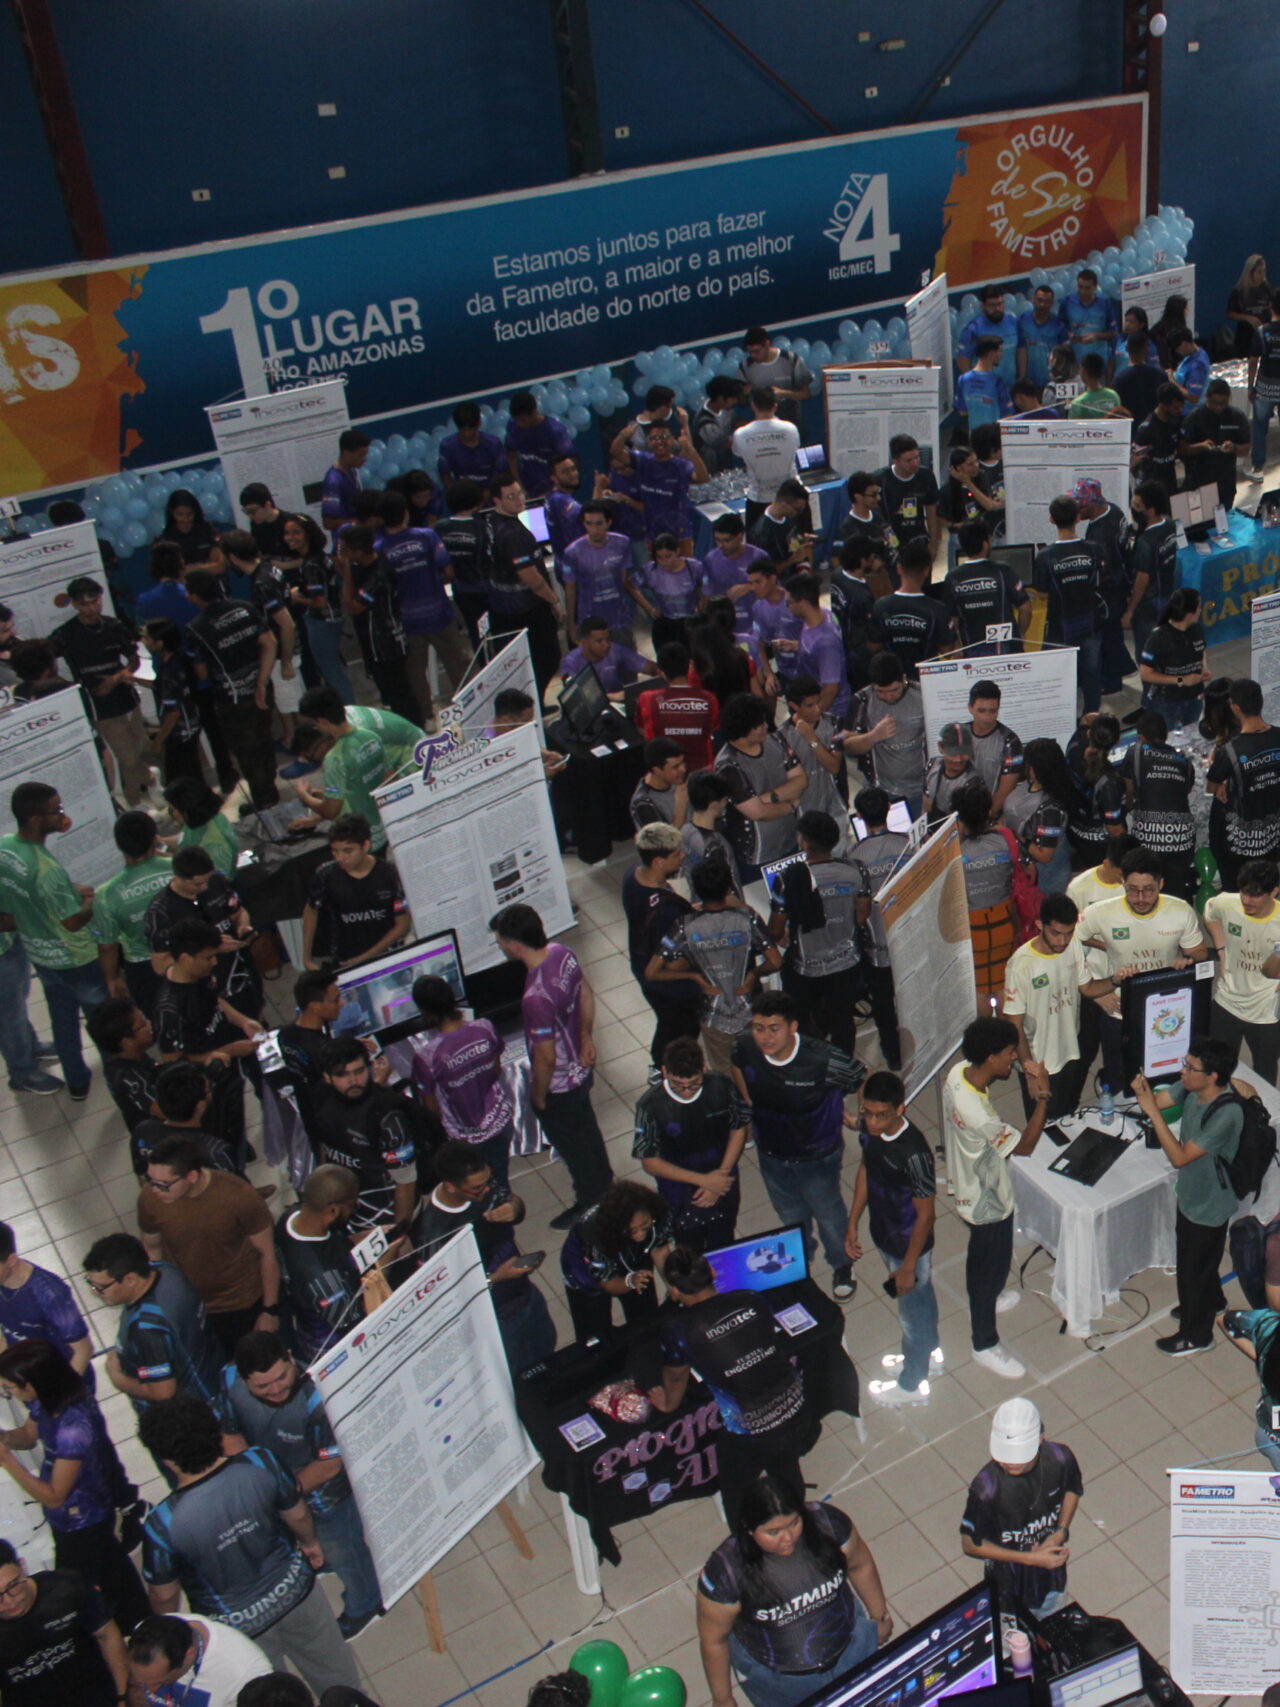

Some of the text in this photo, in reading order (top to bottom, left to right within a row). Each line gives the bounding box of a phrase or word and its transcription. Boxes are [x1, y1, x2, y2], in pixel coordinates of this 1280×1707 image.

[996, 124, 1094, 188] ORGULHO
[824, 172, 873, 243] NOTA
[991, 166, 1086, 218] de Ser
[841, 173, 901, 275] 4
[987, 202, 1081, 258] FAMETRO
[493, 209, 767, 279] Estamos juntos para fazer
[466, 233, 795, 317] da Fametro, a maior e a melhor
[830, 261, 874, 280] IGC/MEC
[494, 266, 775, 343] faculdade do norte do país.
[265, 297, 423, 359] LUGAR
[307, 334, 426, 374] AMAZONAS
[859, 374, 924, 387] inovatec
[1058, 386, 1077, 397] 31
[1040, 426, 1114, 439] inovatec
[0, 540, 75, 567] novatec
[1053, 557, 1093, 570] inovatec
[955, 578, 998, 593] inovatec
[1222, 553, 1280, 592] PRÓ
[885, 616, 927, 630] inovatec
[987, 626, 1012, 641] 27
[963, 661, 1032, 677] inovatec
[441, 706, 464, 727] 28
[659, 699, 709, 712] inovatec
[0, 710, 62, 742] vatec
[428, 747, 516, 793] inovatec
[911, 819, 927, 844] 16
[120, 872, 174, 901] inovate
[1133, 949, 1158, 959] SAVE
[356, 1232, 386, 1270] 15
[358, 1265, 449, 1354] inovatec
[705, 1307, 757, 1341] inovatec
[1180, 1485, 1235, 1498] FAMETRO
[777, 1591, 838, 1628] SOLUTIONS
